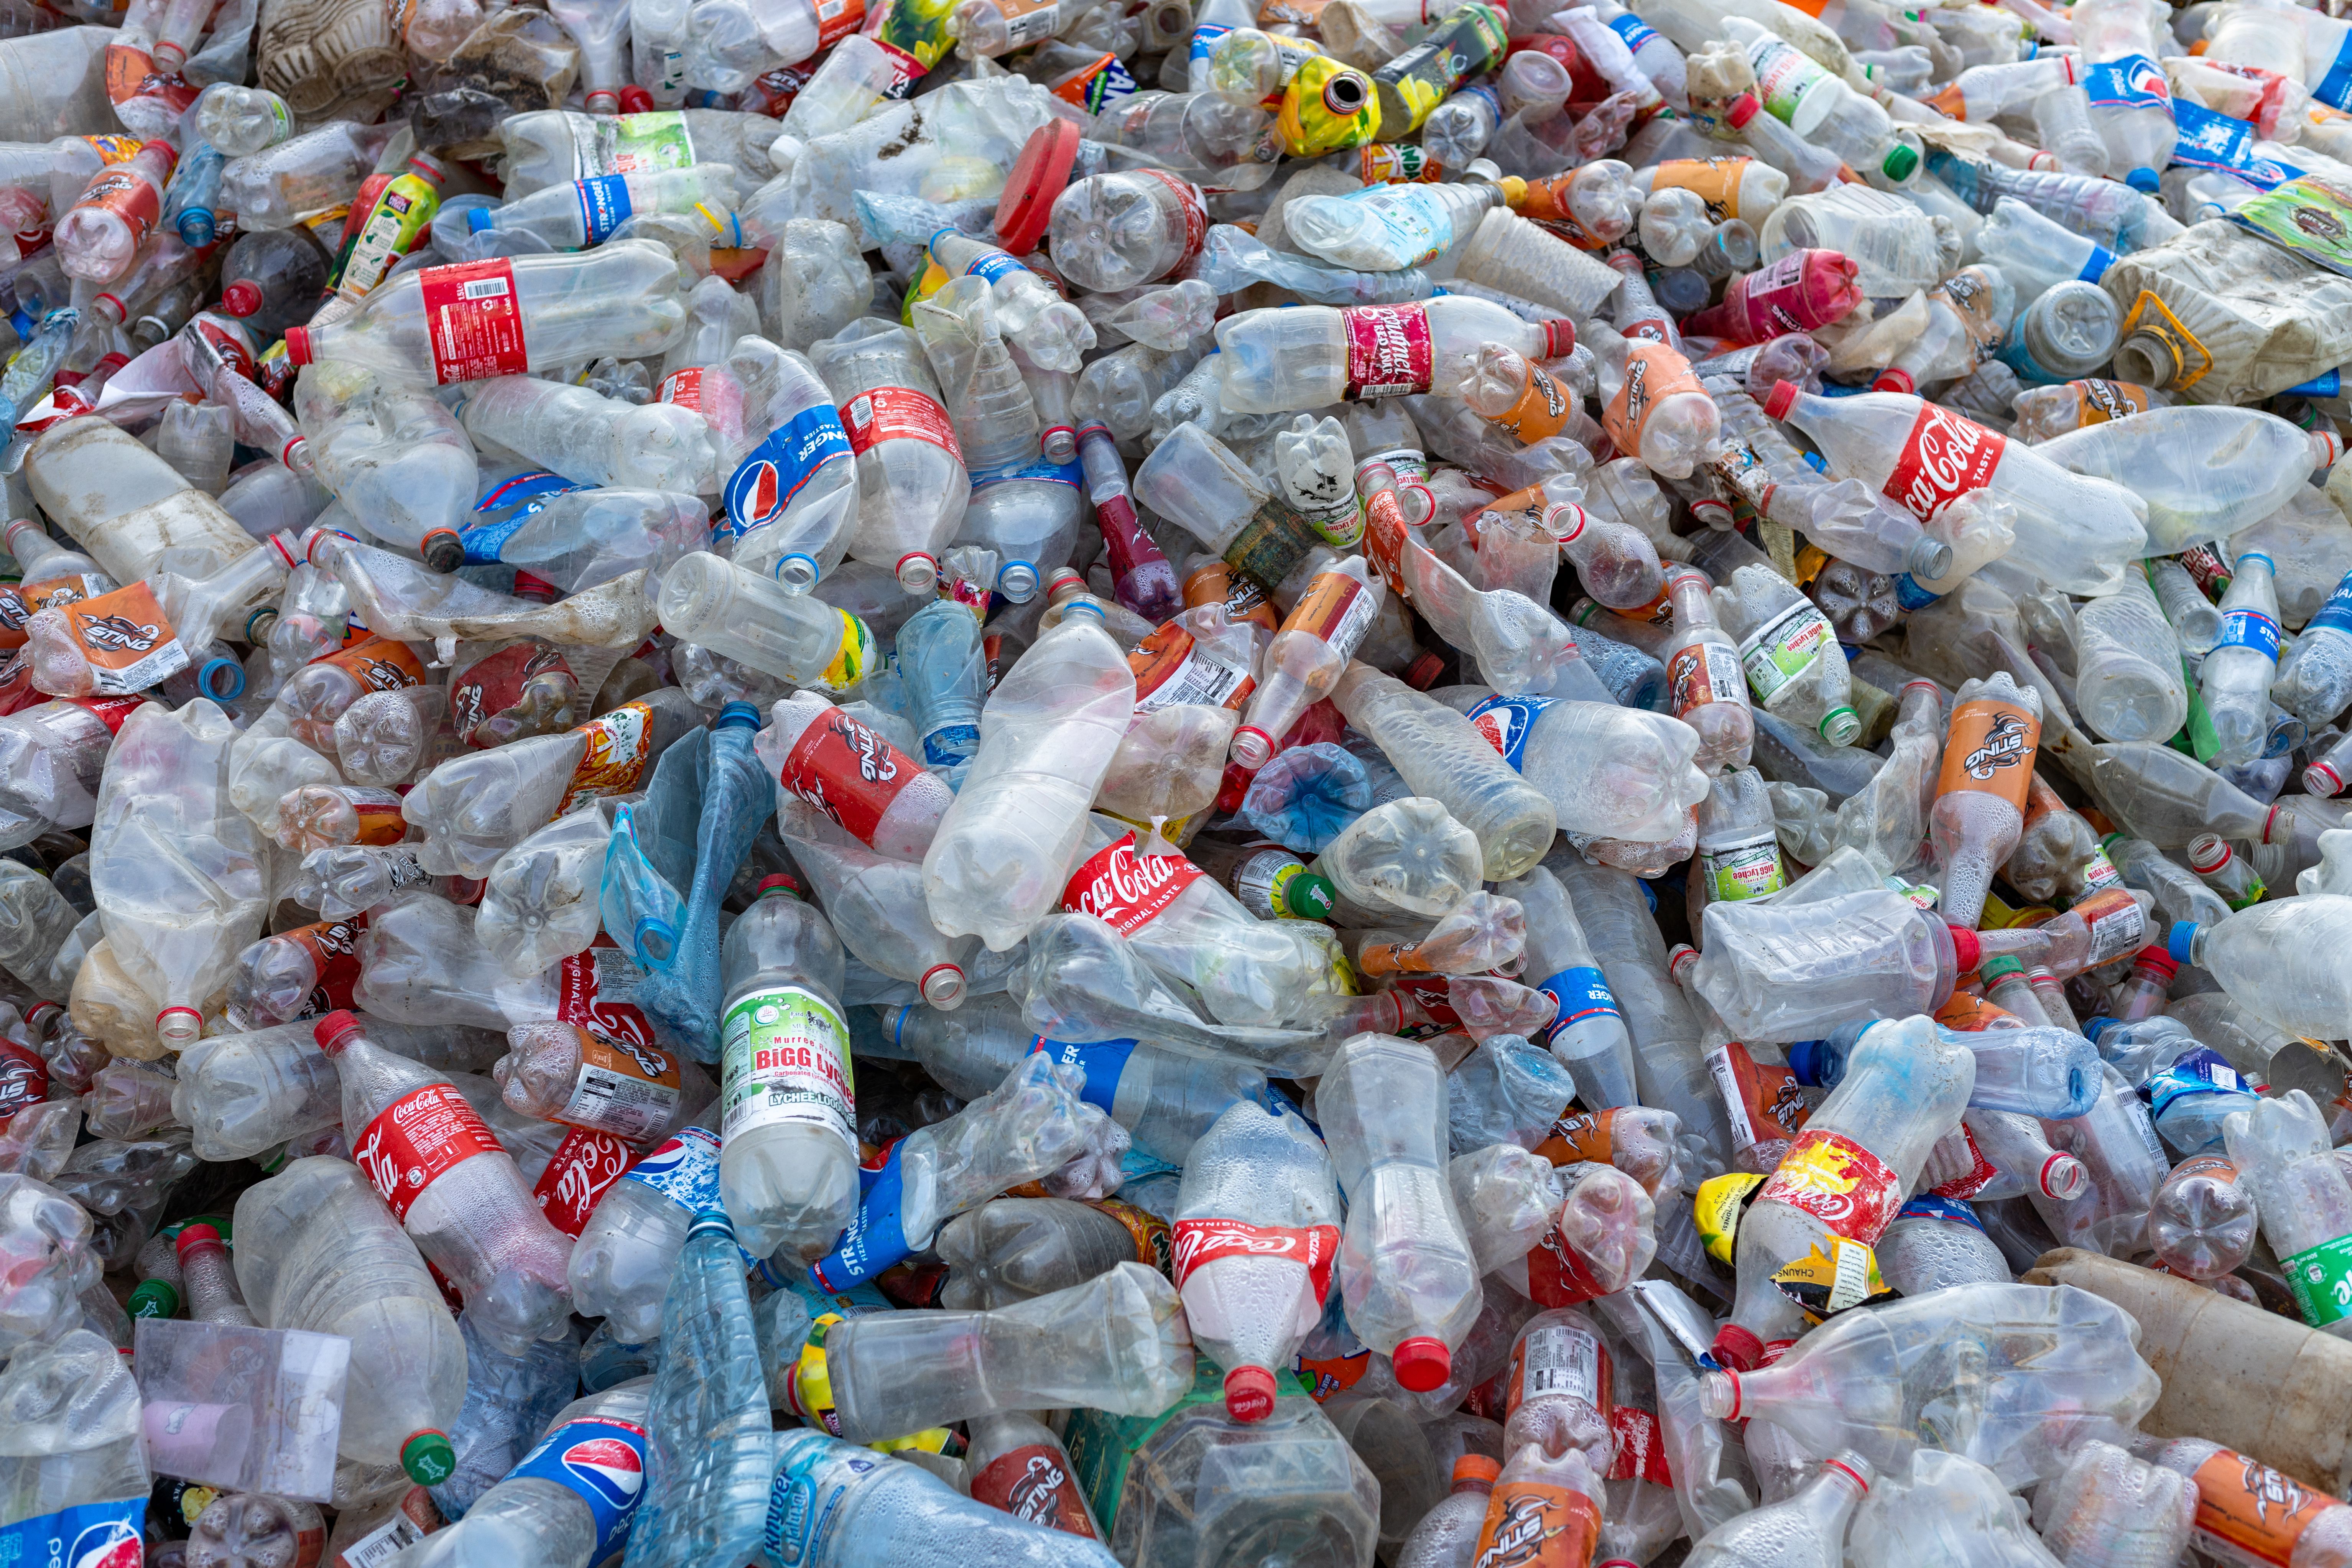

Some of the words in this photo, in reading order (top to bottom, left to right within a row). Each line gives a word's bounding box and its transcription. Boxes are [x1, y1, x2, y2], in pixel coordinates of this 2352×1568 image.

[768, 72, 804, 91] STIN
[1534, 367, 1558, 418] STING
[1630, 360, 1648, 421] STING
[796, 425, 849, 462] ONGER
[803, 423, 836, 441] TASTIER
[1905, 405, 1980, 519] ca-Cola
[1974, 447, 1995, 482] TASTE
[771, 509, 781, 520] NEW
[1324, 519, 1349, 531] Lychee
[1224, 582, 1262, 614] STIN
[91, 624, 155, 652] STING
[1786, 633, 1809, 652] Lychee
[371, 667, 403, 691] STIN
[1218, 675, 1237, 701] STING
[468, 683, 483, 732] TING
[813, 733, 827, 750] BERRY
[855, 724, 878, 783] STING
[1964, 733, 2023, 773] STING
[802, 749, 815, 767] BLAST
[1732, 868, 1759, 880] Lychee
[1759, 863, 1775, 875] BiGG
[1066, 845, 1174, 921] oca-Cola
[1116, 909, 1152, 936] RIGINAL
[1151, 883, 1181, 913] TASTE
[773, 1037, 814, 1047] Murree
[590, 1069, 617, 1081] STING
[756, 1047, 812, 1071] BiGG
[816, 1052, 855, 1106] Lyche
[393, 1088, 442, 1124] Coca-Cola
[769, 1091, 815, 1107] LYCHEE
[1777, 1092, 1806, 1125] STING
[401, 1110, 426, 1127] ORIGINAL
[427, 1103, 443, 1114] TASTE
[554, 1130, 583, 1171] TASTE
[1187, 1221, 1256, 1232] ORIGINAL
[1777, 1269, 1814, 1278] CHAUNS
[1234, 1396, 1267, 1413] Coca-Cola
[1018, 1467, 1065, 1522] STING
